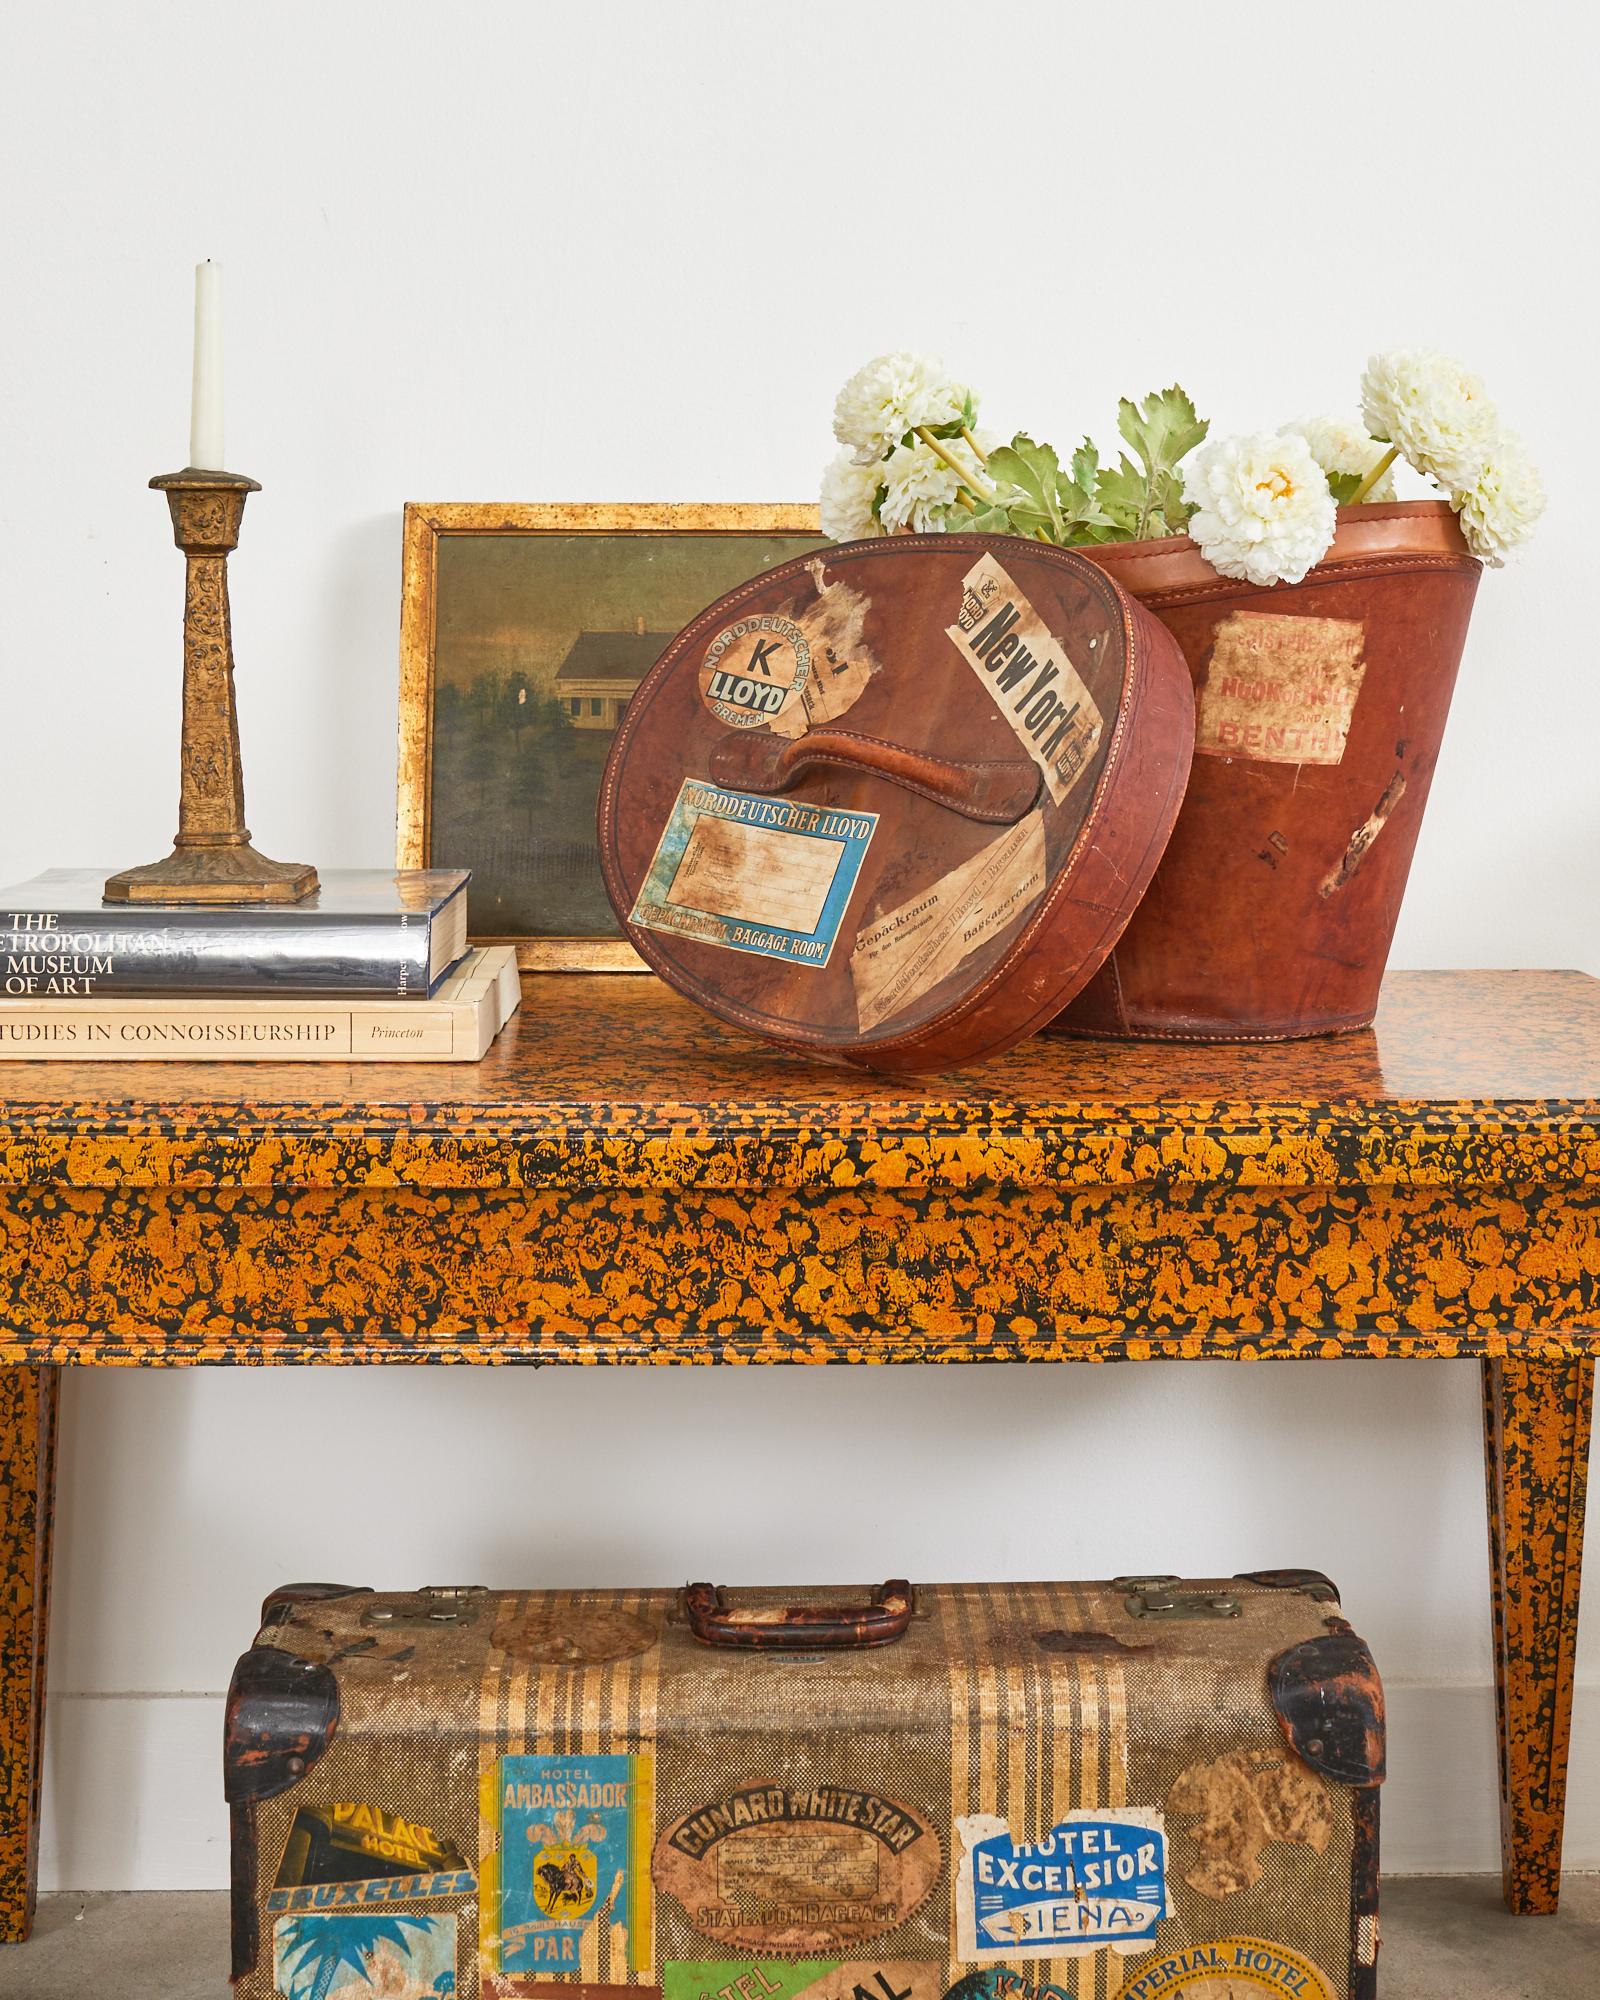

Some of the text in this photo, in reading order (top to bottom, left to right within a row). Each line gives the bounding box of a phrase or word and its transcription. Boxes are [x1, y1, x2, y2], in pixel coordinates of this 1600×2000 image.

[704, 617, 811, 692] NORDDEUTSCHER
[747, 639, 783, 676] K
[708, 671, 786, 713] LLOYD
[969, 601, 1081, 762] New York
[712, 701, 765, 727] BREMEN
[1300, 714, 1321, 724] AND
[684, 787, 870, 840] NORDDEUTSCHER LLOYD
[8, 913, 59, 931] THE
[732, 927, 790, 953] BAGGAGE
[790, 940, 826, 959] ROOM
[5, 955, 114, 975] MUSEUM
[5, 976, 97, 994] OF ART
[87, 1024, 111, 1041] IN
[120, 1024, 336, 1041] CONNOISSEURSHIP
[371, 1026, 424, 1039] Princeton
[541, 1769, 592, 1780] HOTEL
[503, 1783, 628, 1809] AMBASSADOR
[333, 1802, 442, 1857] PALACE
[675, 1787, 916, 1854] CUNARD WHITE STAR
[361, 1835, 429, 1866] HOTEL
[1012, 1829, 1121, 1859] HOTEL
[978, 1843, 1159, 1892] EXCELSIOR
[267, 1872, 478, 1911] BRUXELLES
[806, 1903, 897, 1925] BAGGAGE
[1234, 1948, 1310, 1998] HOTEL
